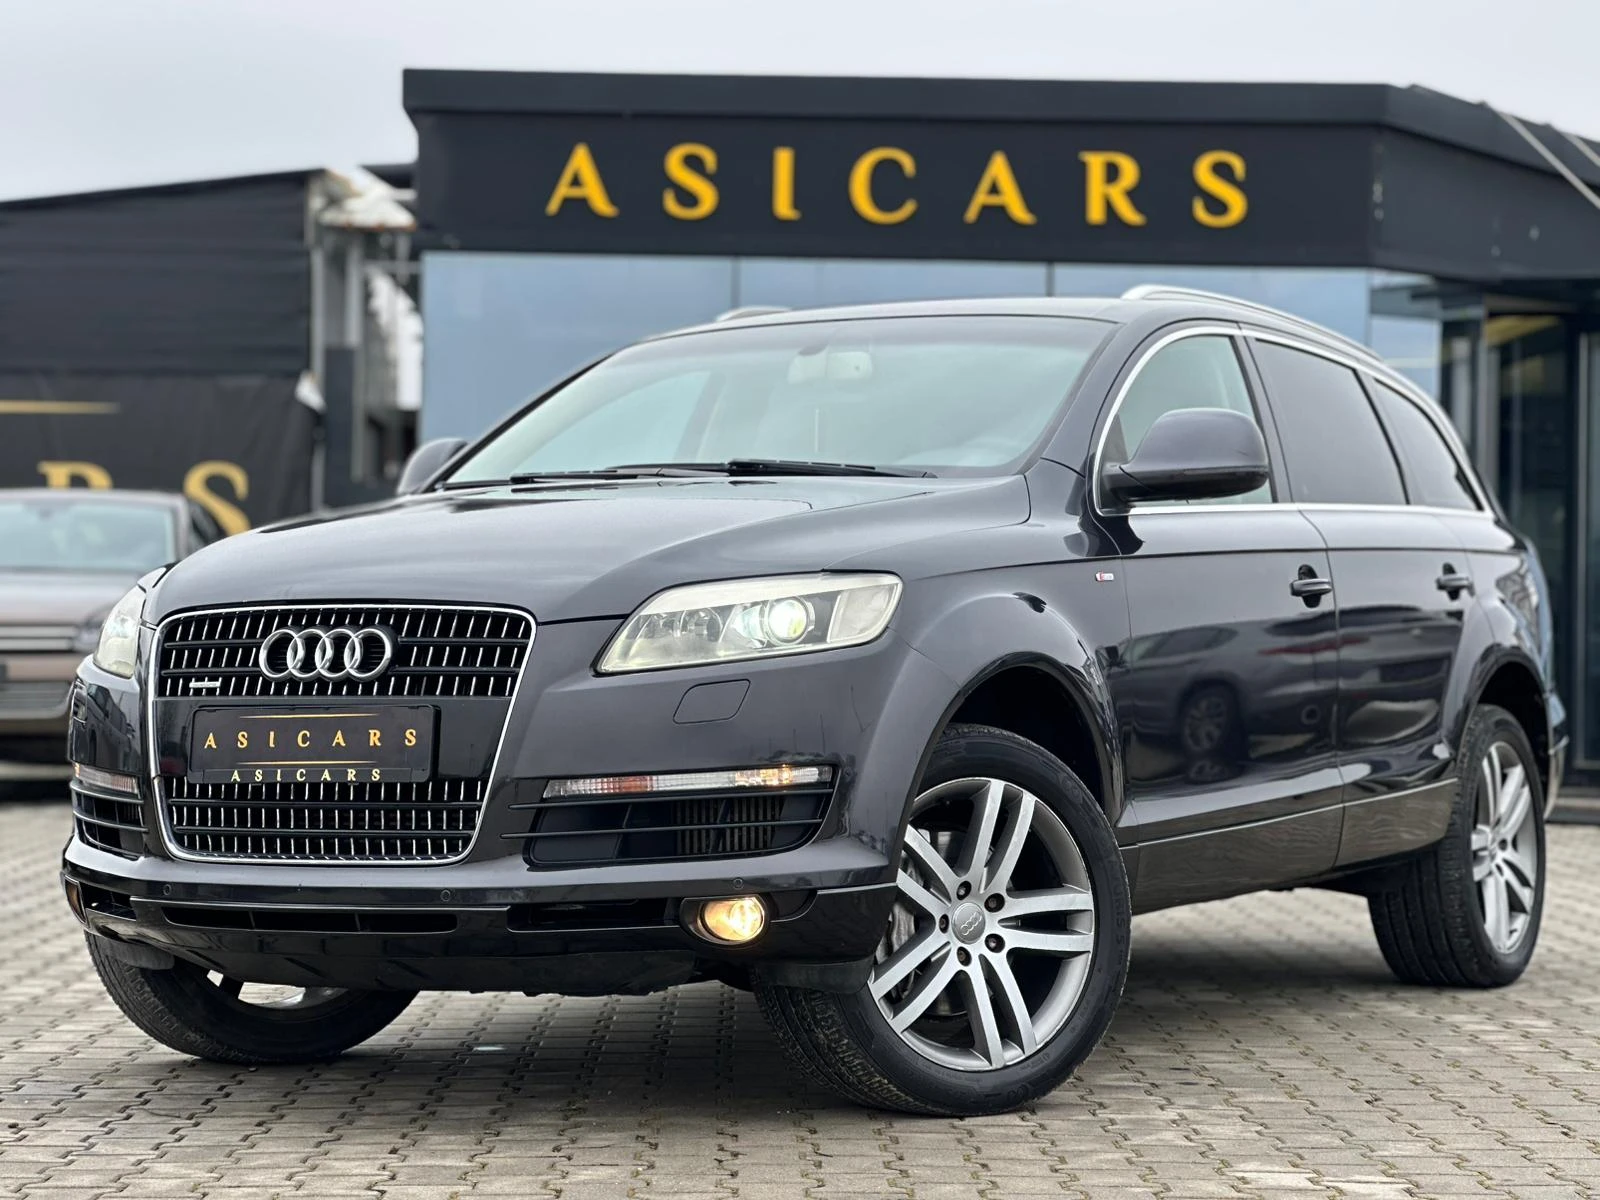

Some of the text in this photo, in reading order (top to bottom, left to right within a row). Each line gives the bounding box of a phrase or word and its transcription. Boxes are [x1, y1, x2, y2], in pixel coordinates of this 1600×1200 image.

[546, 142, 1249, 229] ASICARS
[204, 728, 417, 750] ASICARS
[230, 768, 381, 783] ASICARS
